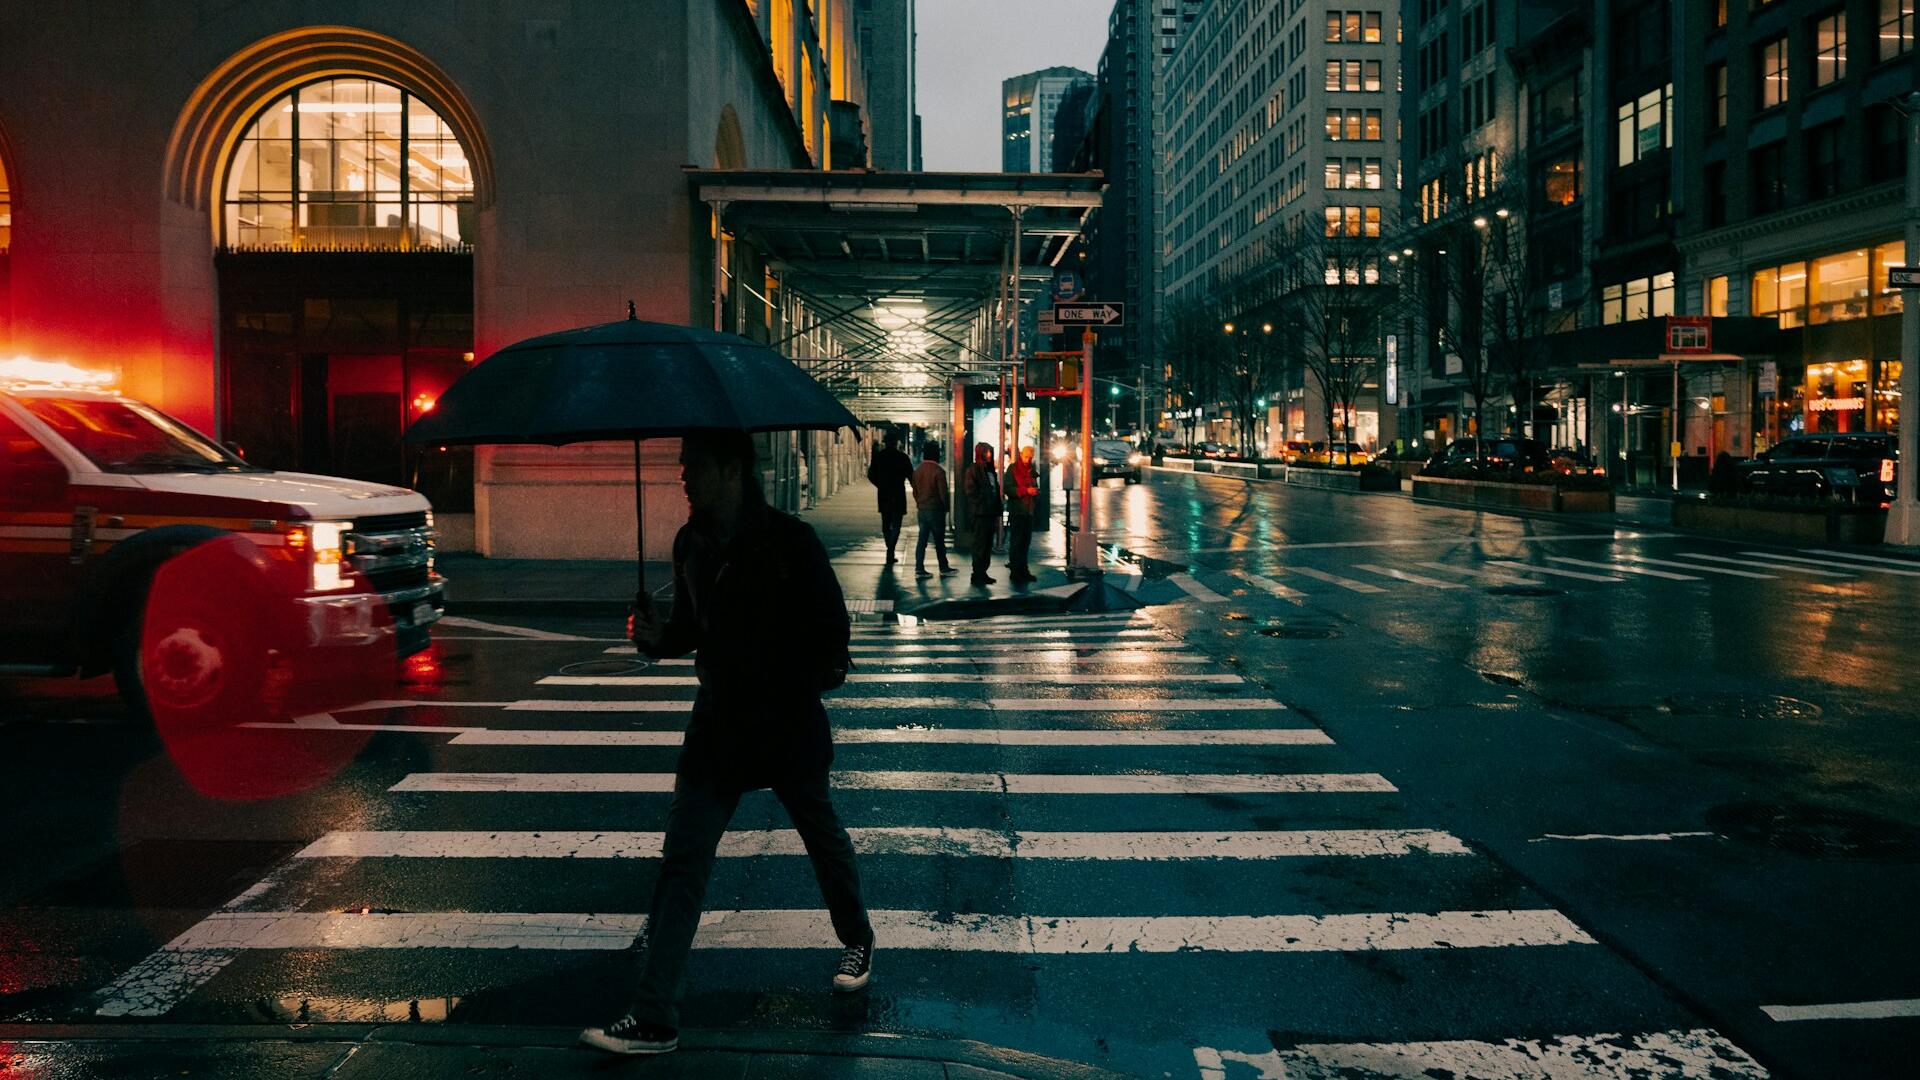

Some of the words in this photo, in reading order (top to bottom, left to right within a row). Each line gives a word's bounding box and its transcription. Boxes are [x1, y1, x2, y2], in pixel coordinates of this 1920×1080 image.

[1894, 273, 1912, 281] ONE
[1064, 309, 1084, 319] ONE
[1092, 309, 1113, 319] WAY
